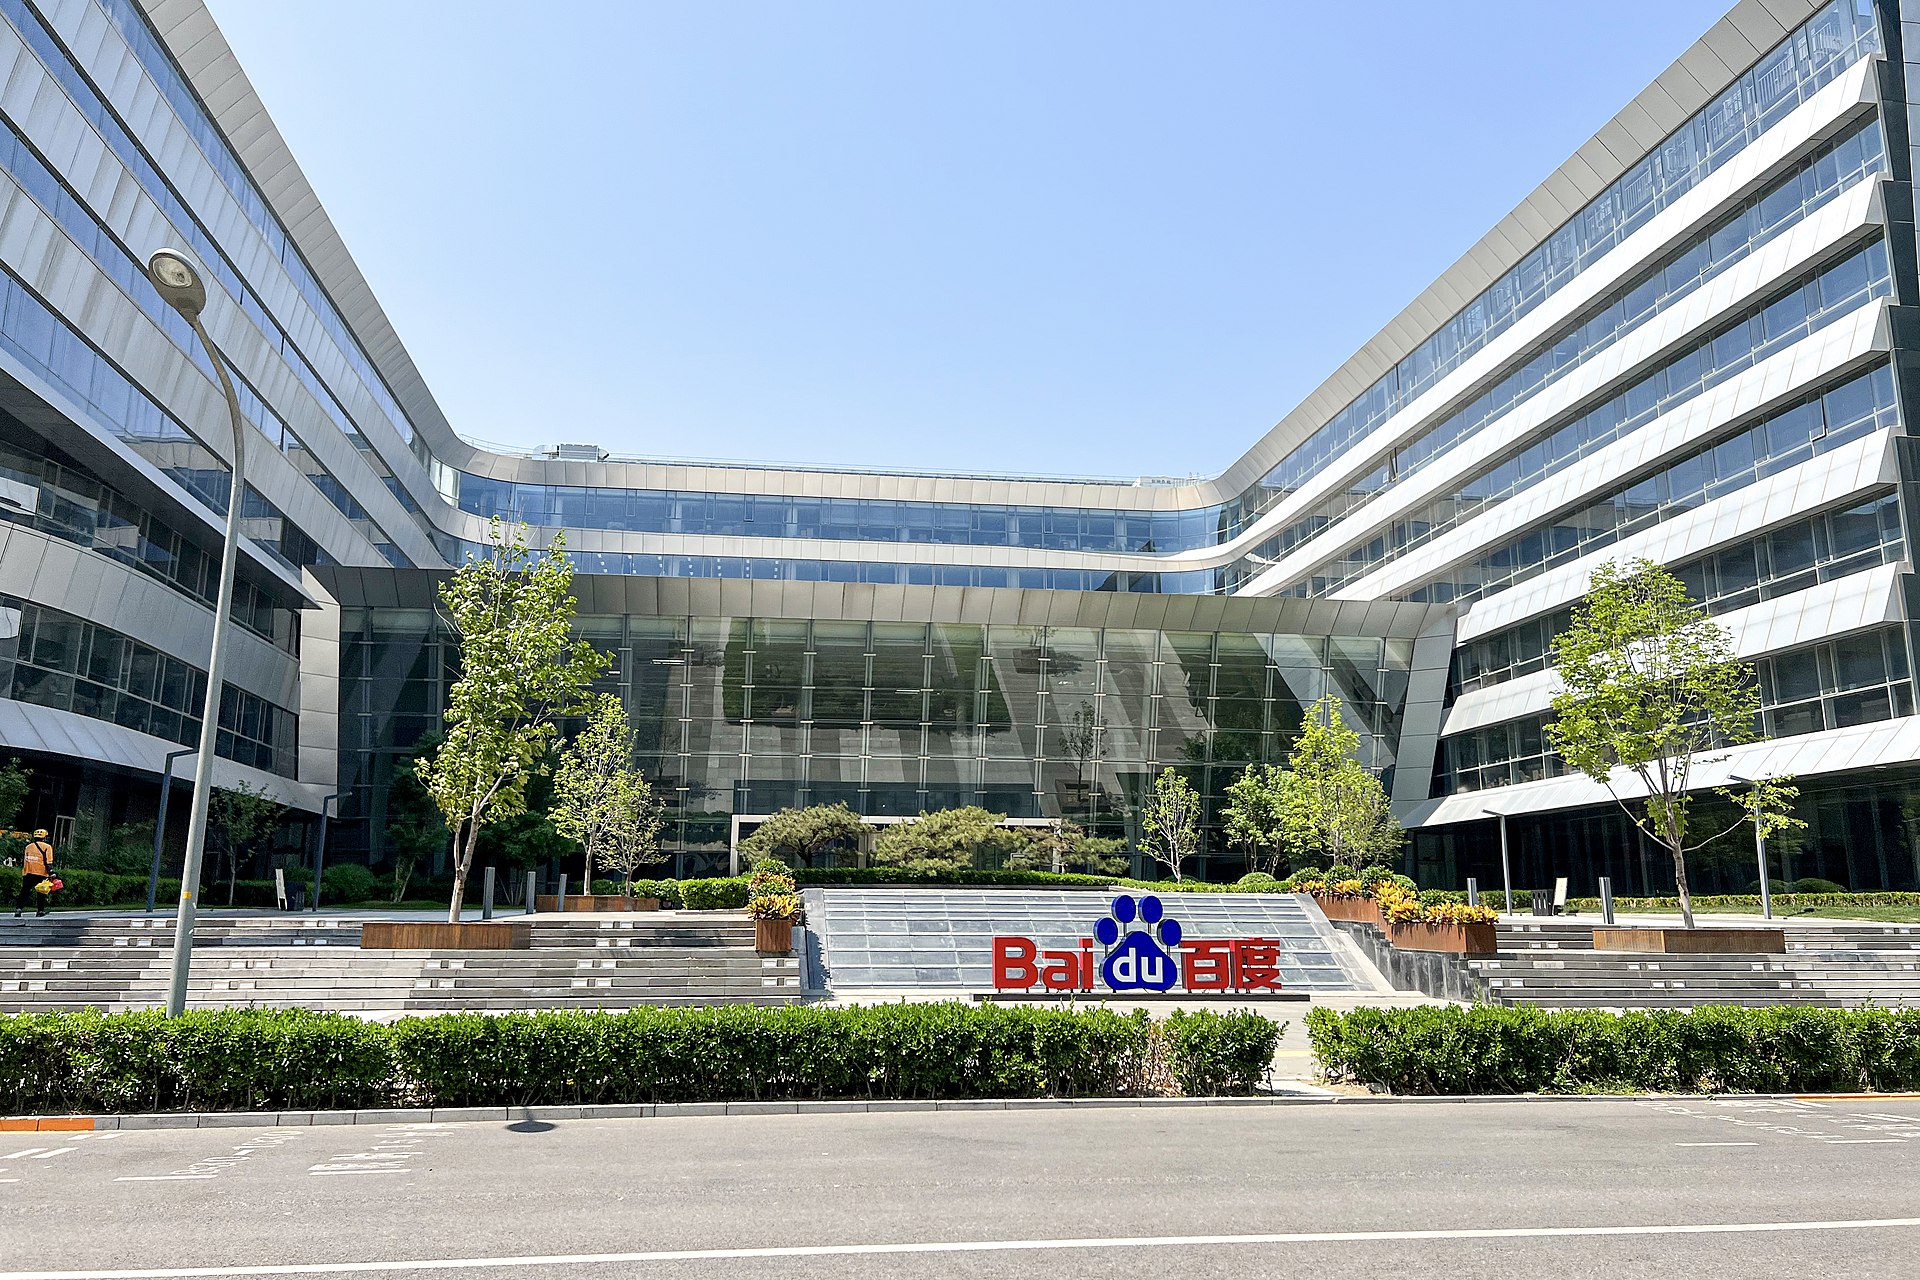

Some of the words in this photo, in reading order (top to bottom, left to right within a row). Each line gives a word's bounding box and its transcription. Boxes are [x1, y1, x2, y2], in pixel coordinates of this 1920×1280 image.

[992, 937, 1093, 990] Bai
[1113, 948, 1163, 983] du
[1180, 937, 1281, 990] 百度
